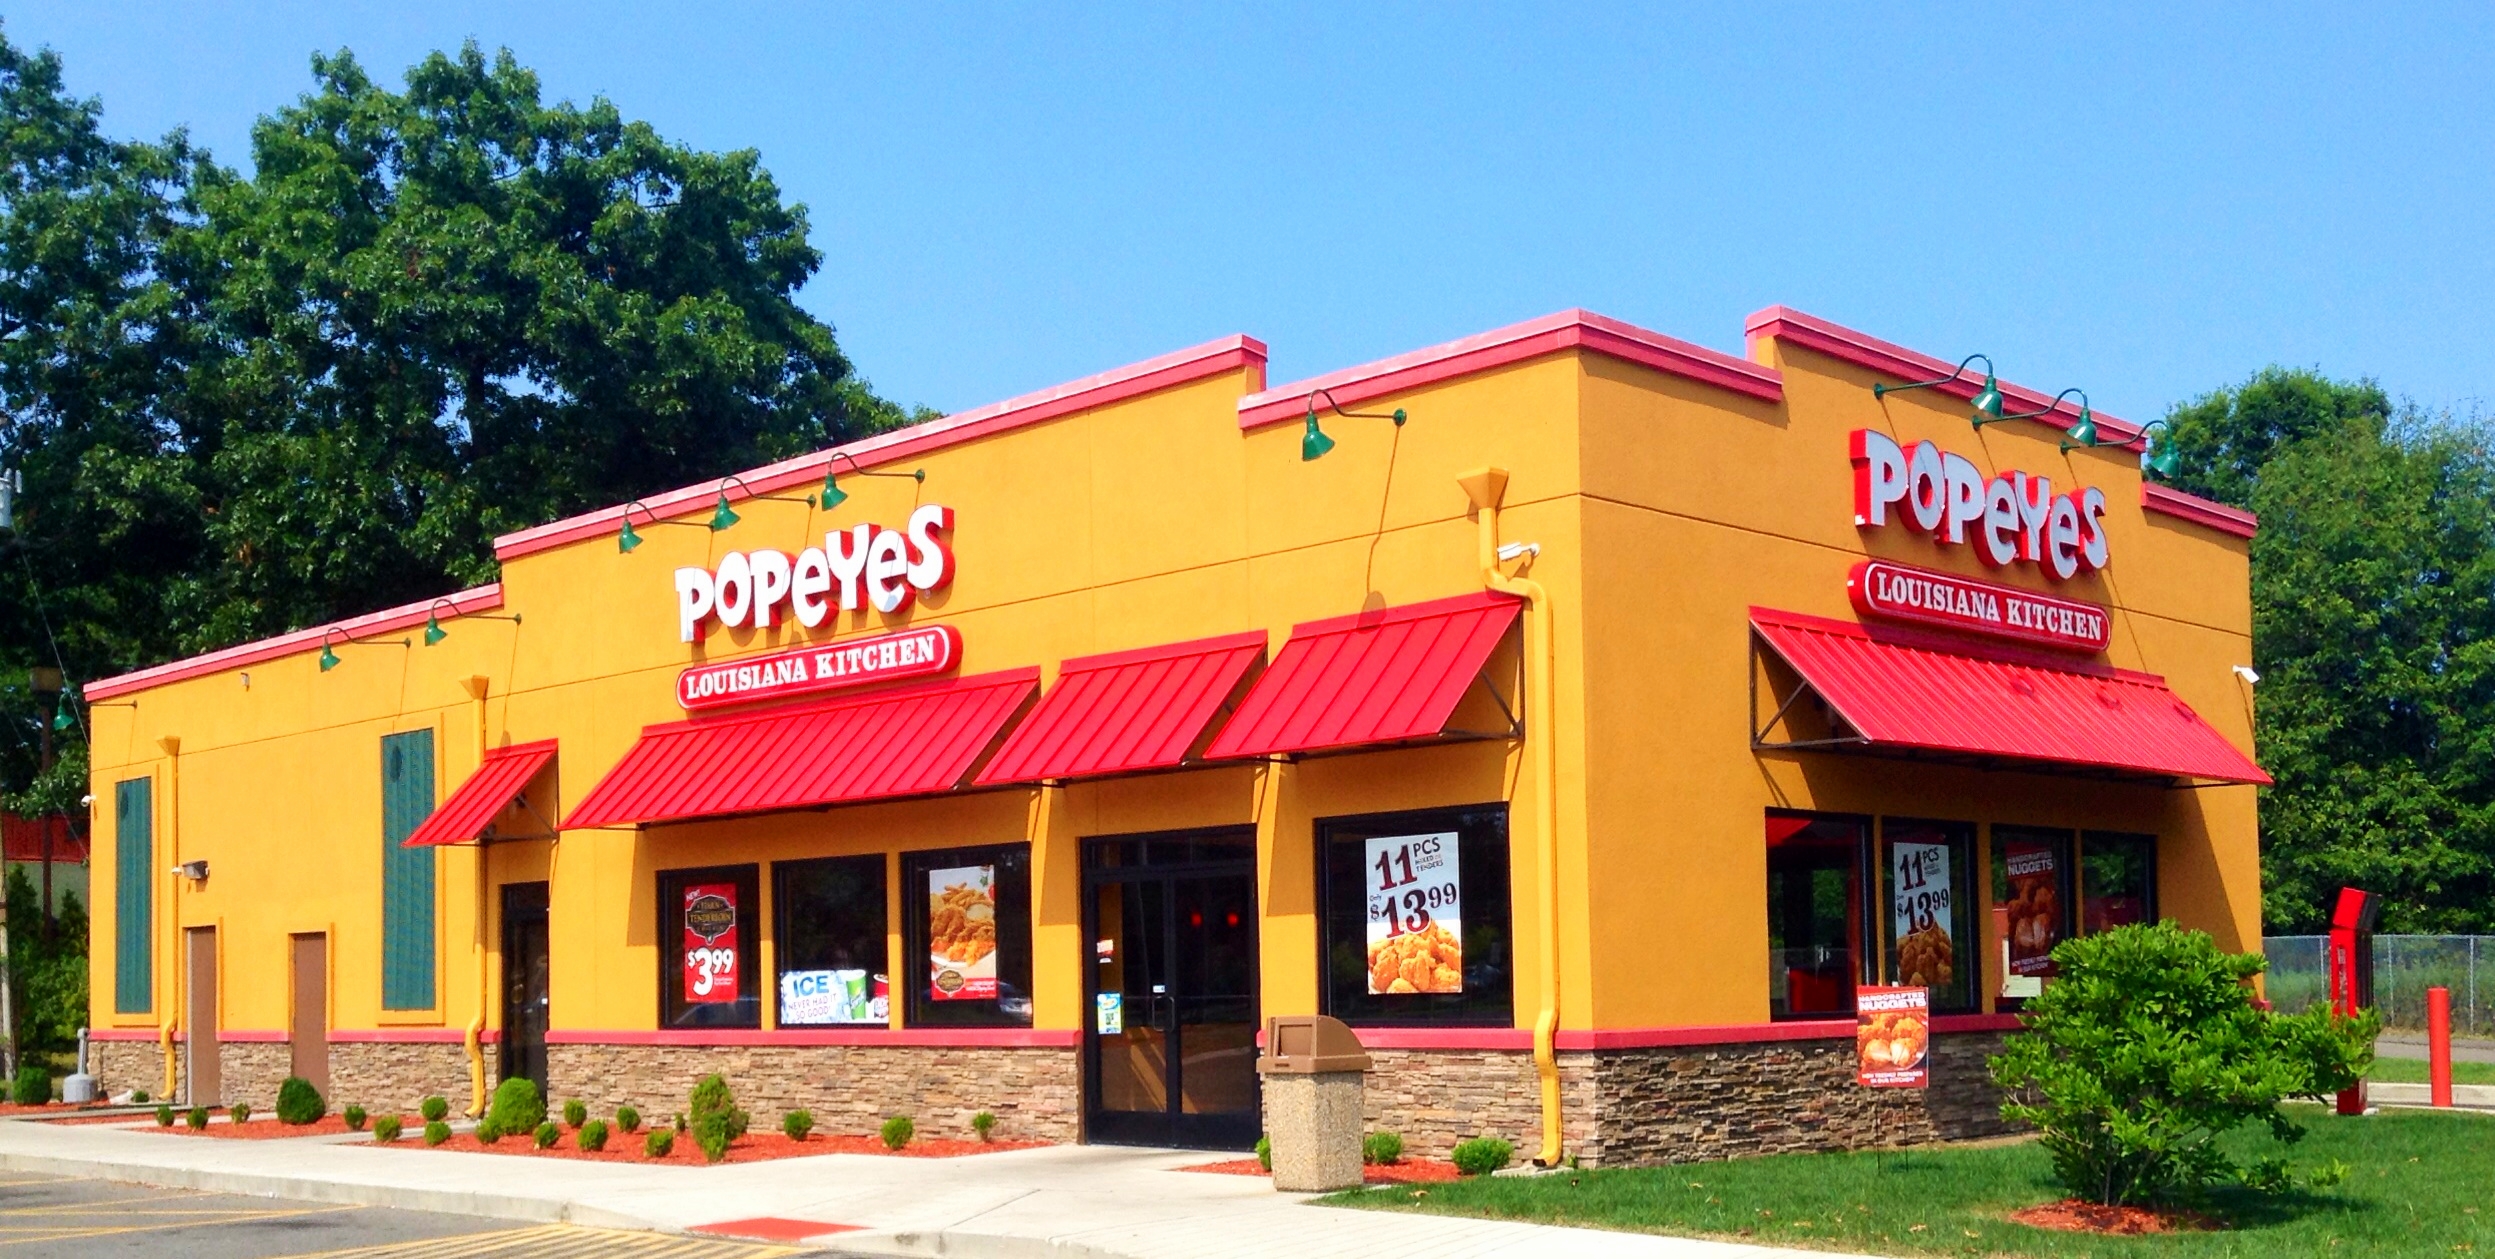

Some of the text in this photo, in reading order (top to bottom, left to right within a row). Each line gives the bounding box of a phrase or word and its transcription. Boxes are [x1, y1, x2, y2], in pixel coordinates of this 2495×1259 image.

[1877, 572, 2102, 641] LOUISIANA KITCHEN
[686, 634, 935, 700] LOUISIANA KITCHEN
[1375, 837, 1441, 891] 11 PCS
[1900, 851, 1926, 891] 11
[1922, 846, 1940, 863] PCS
[2008, 859, 2054, 877] NUGGETS
[793, 975, 830, 998] ICE
[788, 999, 810, 1010] NEVER
[812, 995, 826, 1006] HAD
[830, 993, 837, 1003] IT
[1858, 998, 1926, 1011] NUGGETS
[795, 1010, 806, 1021] SO
